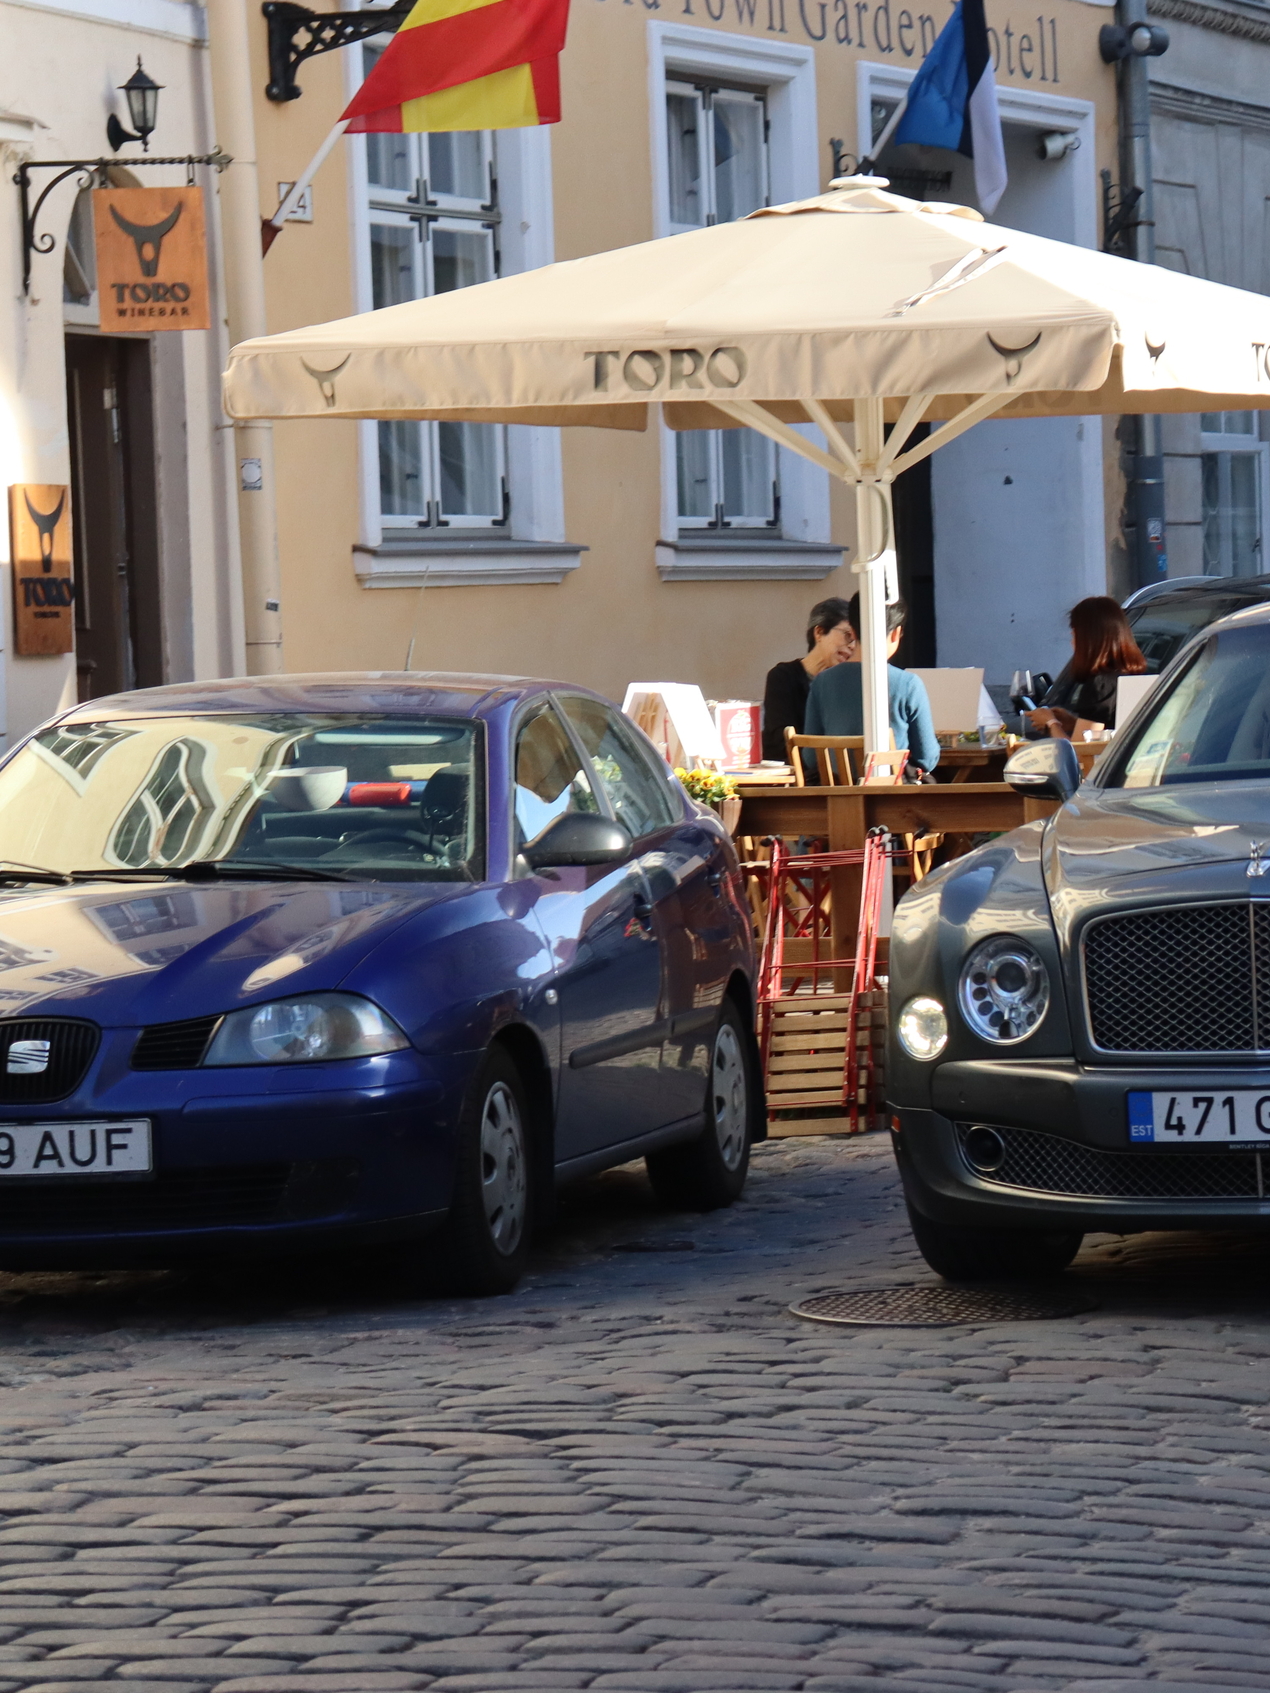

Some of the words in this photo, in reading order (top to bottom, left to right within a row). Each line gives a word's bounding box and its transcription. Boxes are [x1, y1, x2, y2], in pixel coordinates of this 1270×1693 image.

[799, 0, 936, 58] Garden
[985, 15, 1060, 83] otell
[111, 282, 191, 304] TORO
[116, 306, 190, 318] WINEBAR
[583, 346, 749, 393] TORO
[20, 577, 75, 607] TORO
[1131, 1125, 1153, 1137] EST
[1164, 1096, 1237, 1137] 471
[32, 1127, 134, 1169] AUF
